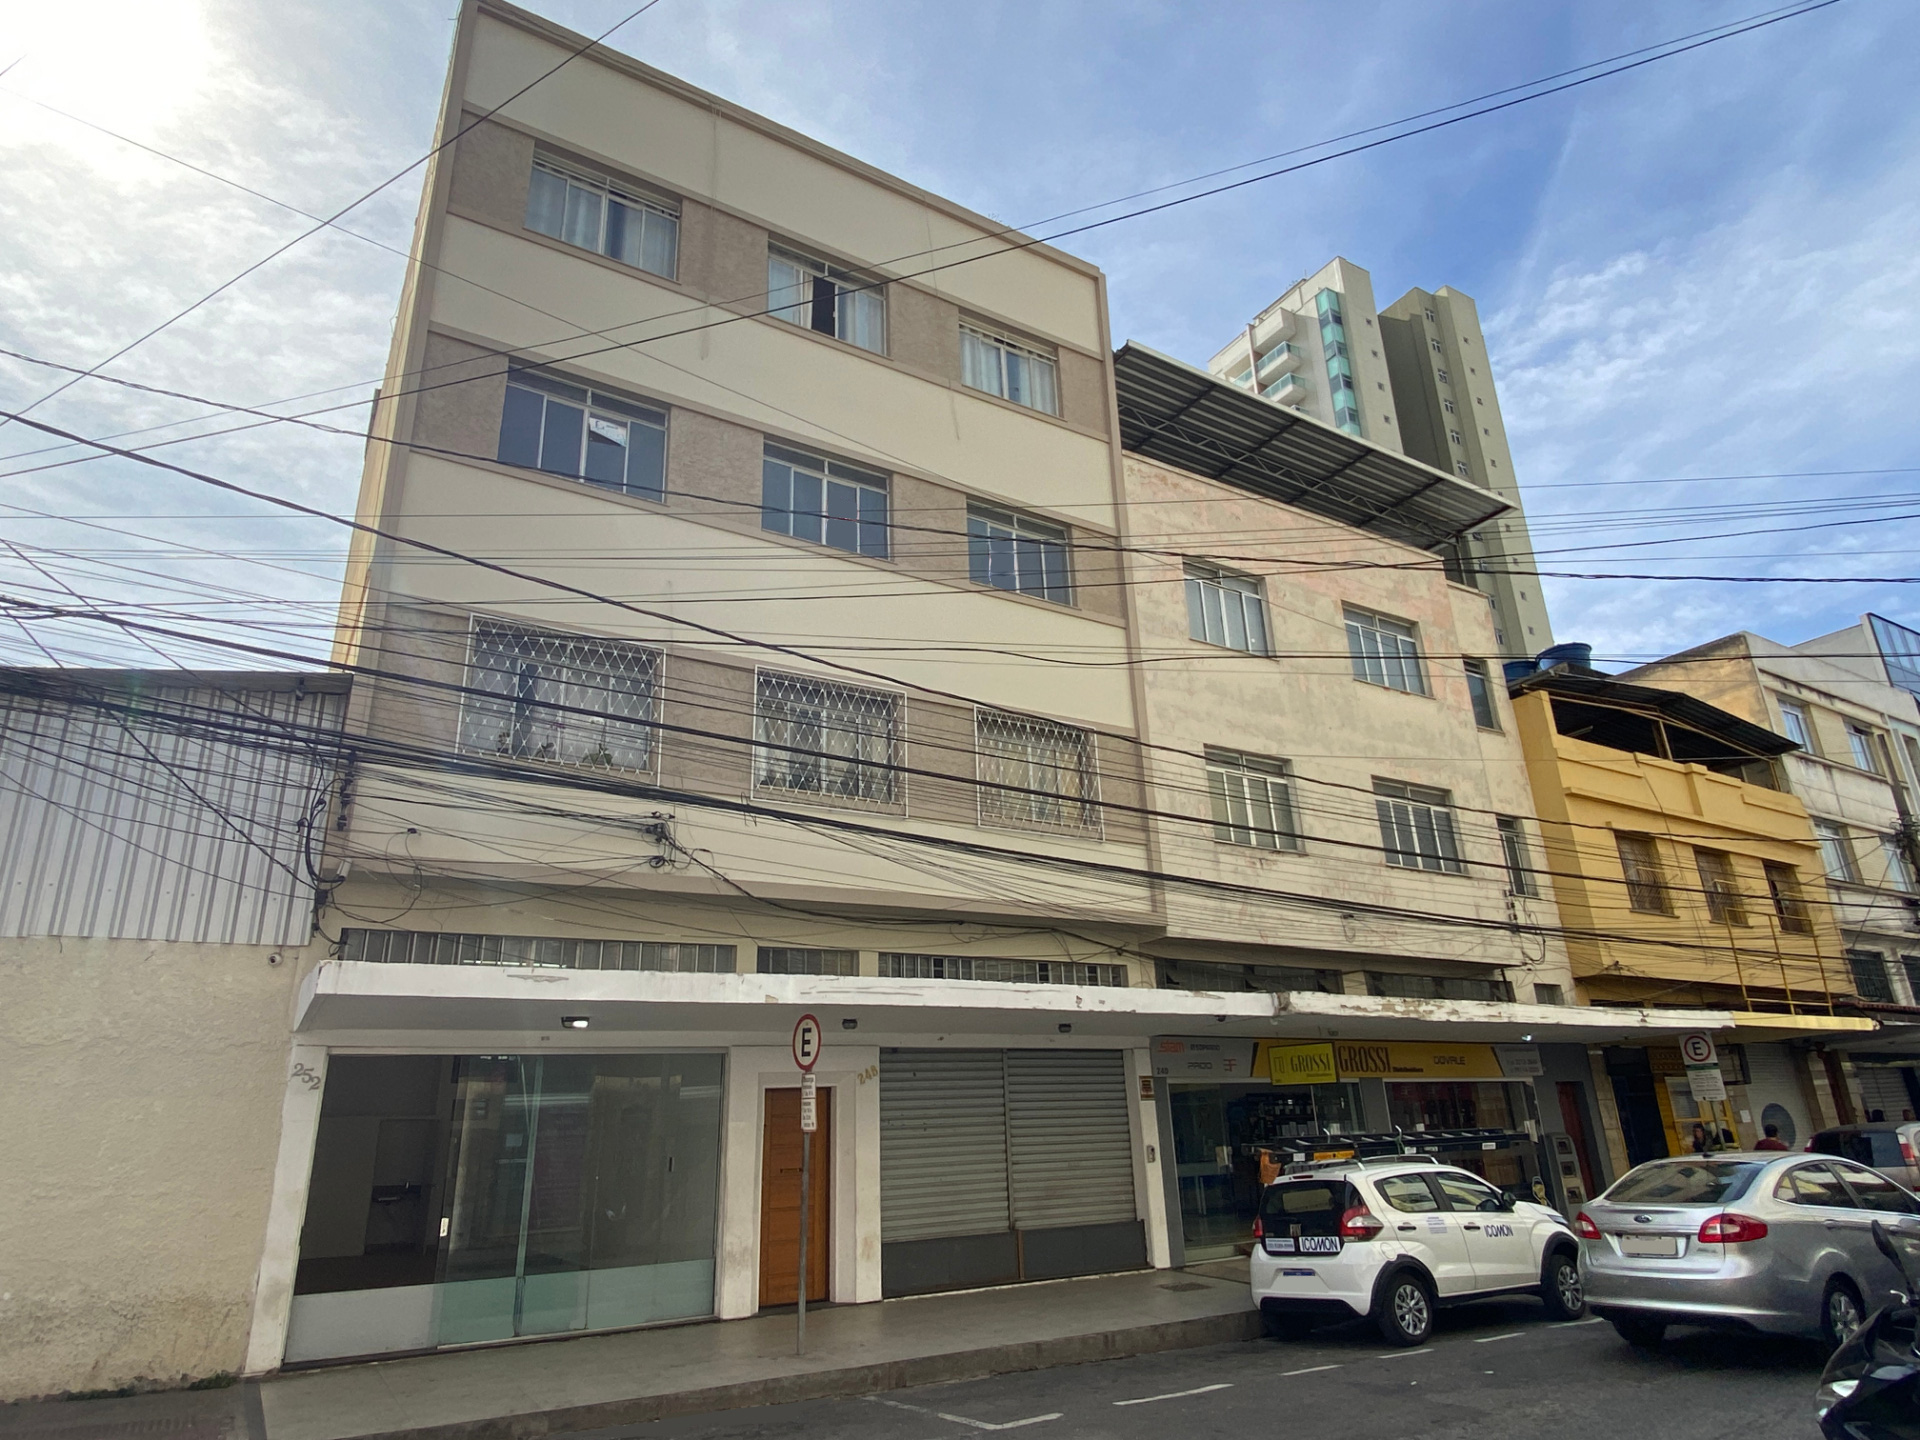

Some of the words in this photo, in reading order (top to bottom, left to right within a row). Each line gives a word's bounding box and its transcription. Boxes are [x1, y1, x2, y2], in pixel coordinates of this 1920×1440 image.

[801, 1027, 812, 1057] E
[1691, 1041, 1704, 1056] E
[1290, 1053, 1331, 1073] GROSSI
[1338, 1045, 1392, 1073] GROSSI
[291, 1062, 321, 1091] 252
[1484, 1224, 1514, 1237] ICOMON
[1301, 1237, 1338, 1251] ICOMON
